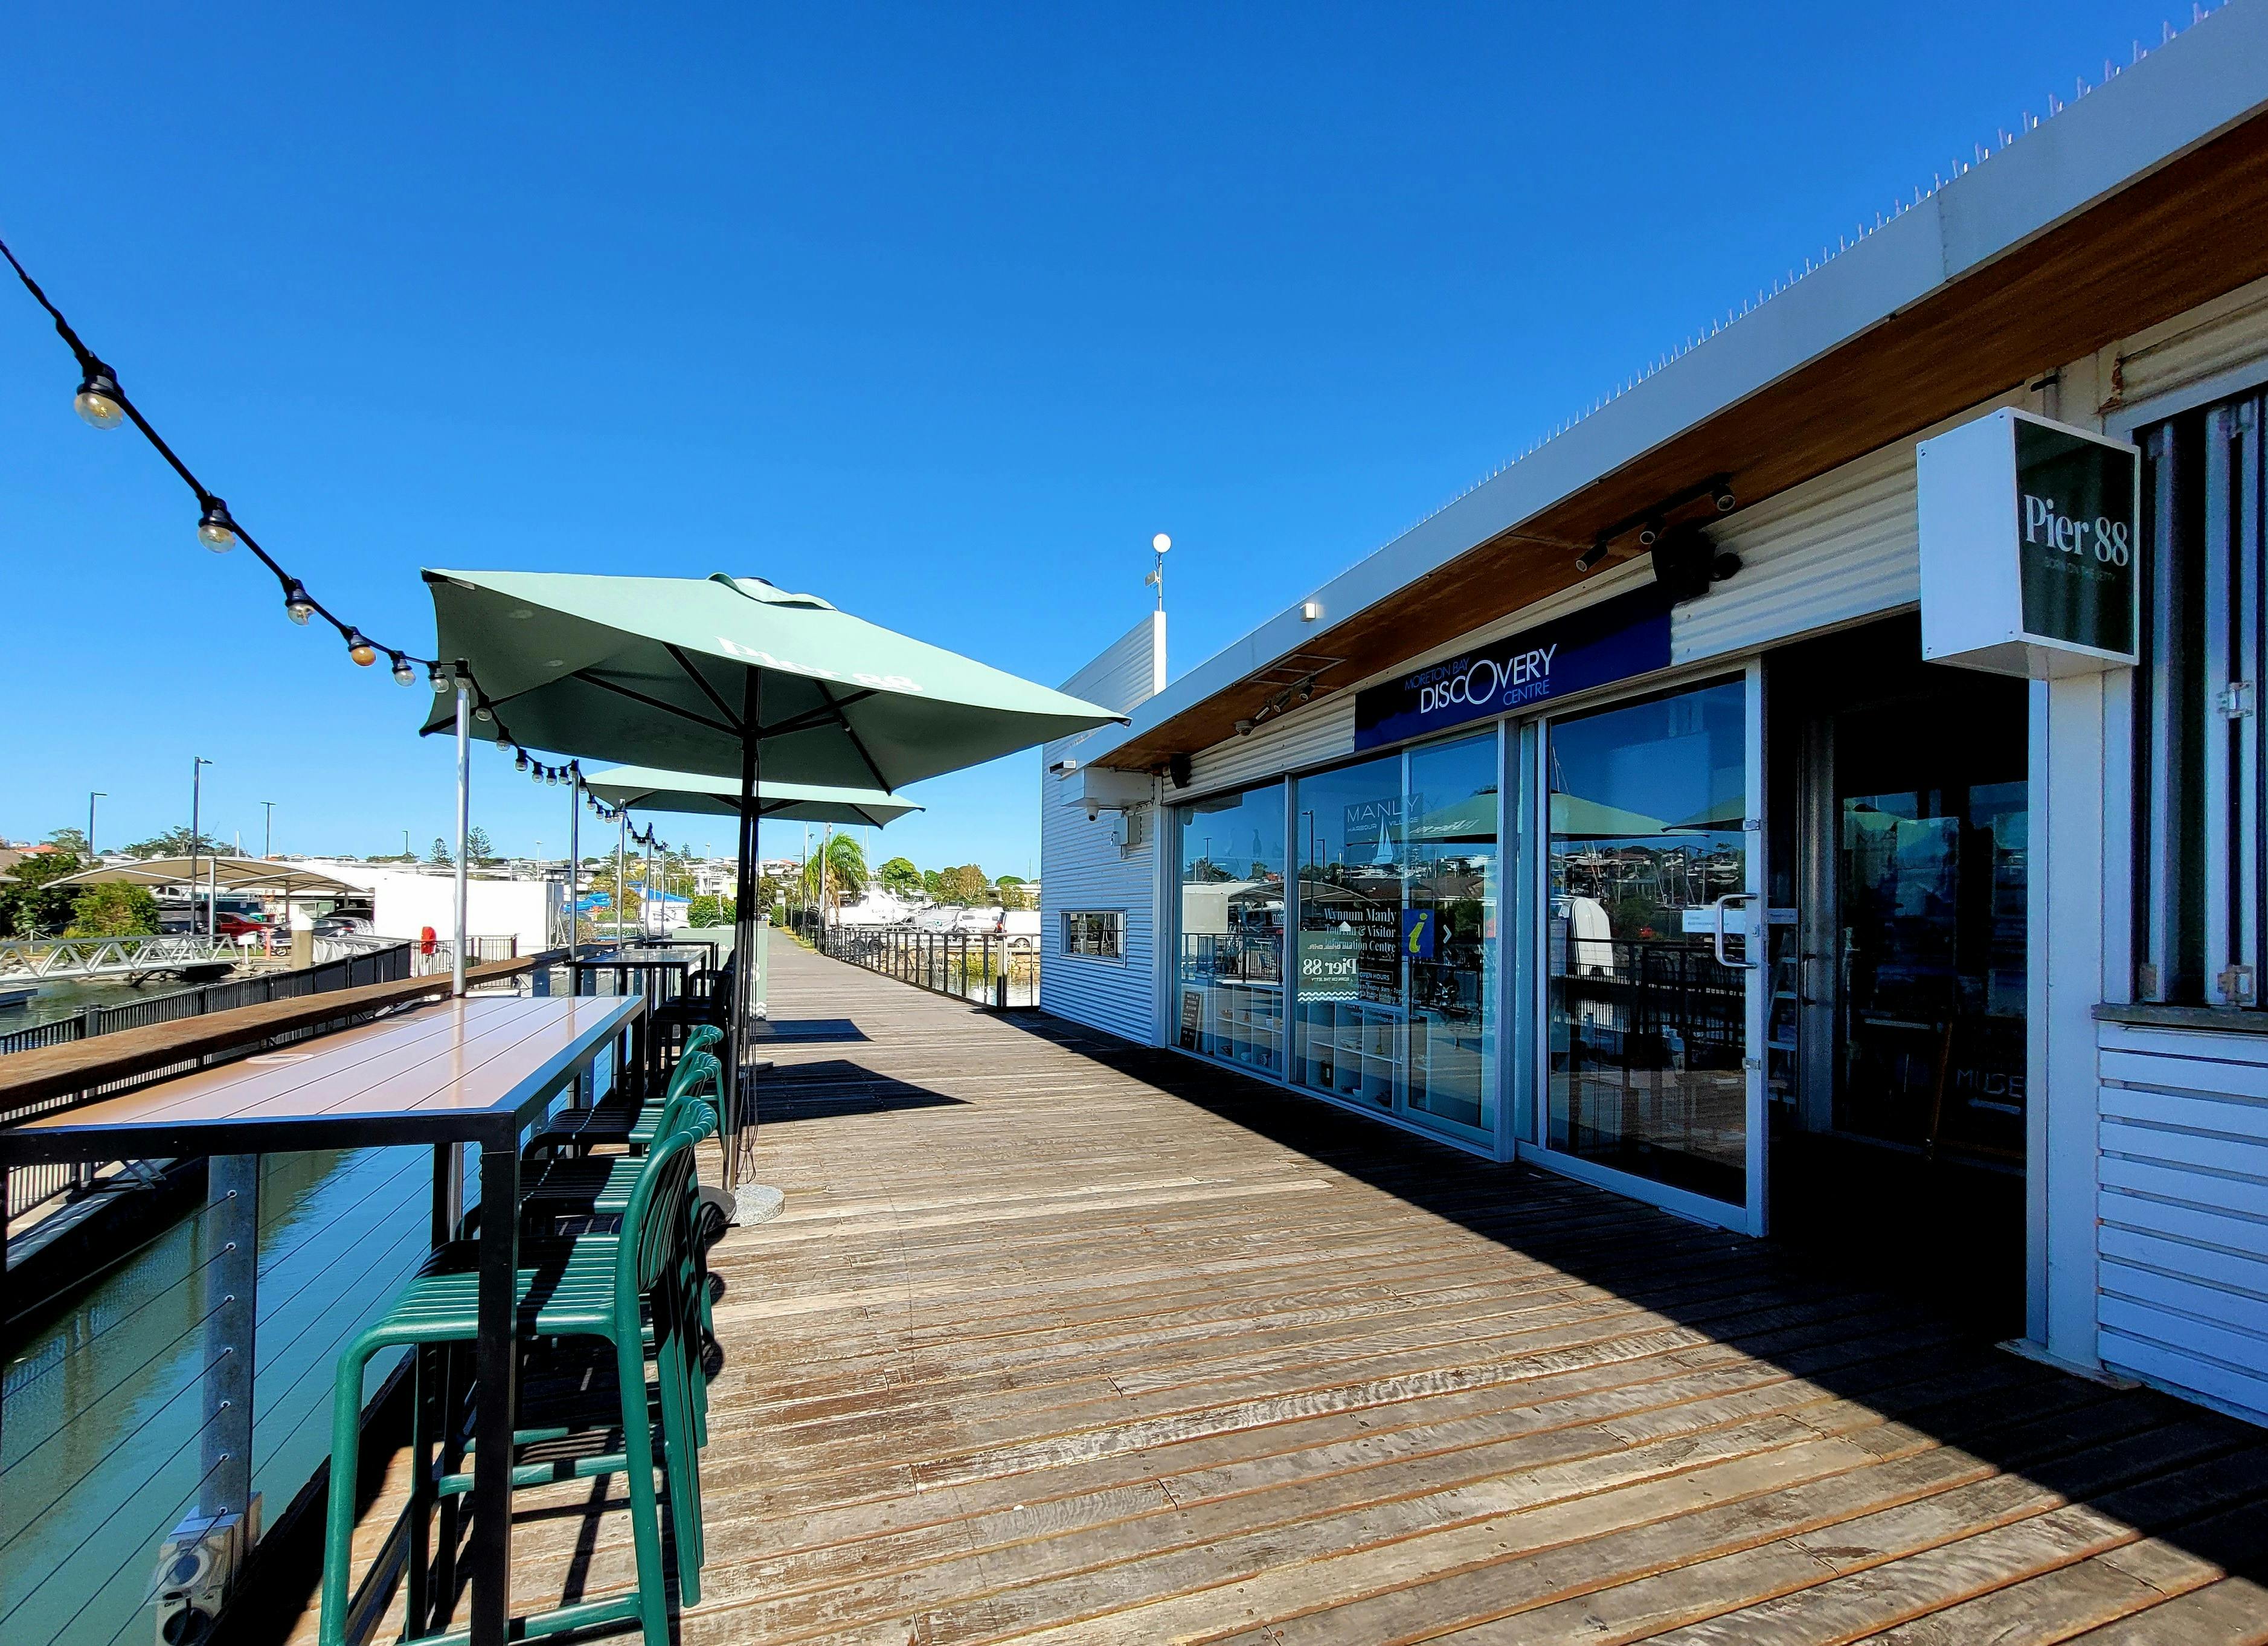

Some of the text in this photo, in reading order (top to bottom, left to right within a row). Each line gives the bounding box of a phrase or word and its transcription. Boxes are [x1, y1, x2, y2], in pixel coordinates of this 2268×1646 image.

[2024, 494, 2128, 567] Pier 88
[715, 635, 924, 693] Pier 88
[1405, 657, 1470, 691] MORETON BAY
[1421, 644, 1557, 714] DISCOVERY
[1503, 680, 1550, 706] CENTRE
[1348, 796, 1419, 823] MANLY
[1348, 823, 1377, 832] HARBOUR
[1389, 817, 1419, 826] VILLGE
[1324, 907, 1397, 925] Wynnum Manly
[1358, 925, 1366, 936] &
[1367, 925, 1396, 937] Visitor
[1369, 940, 1396, 953] Centre
